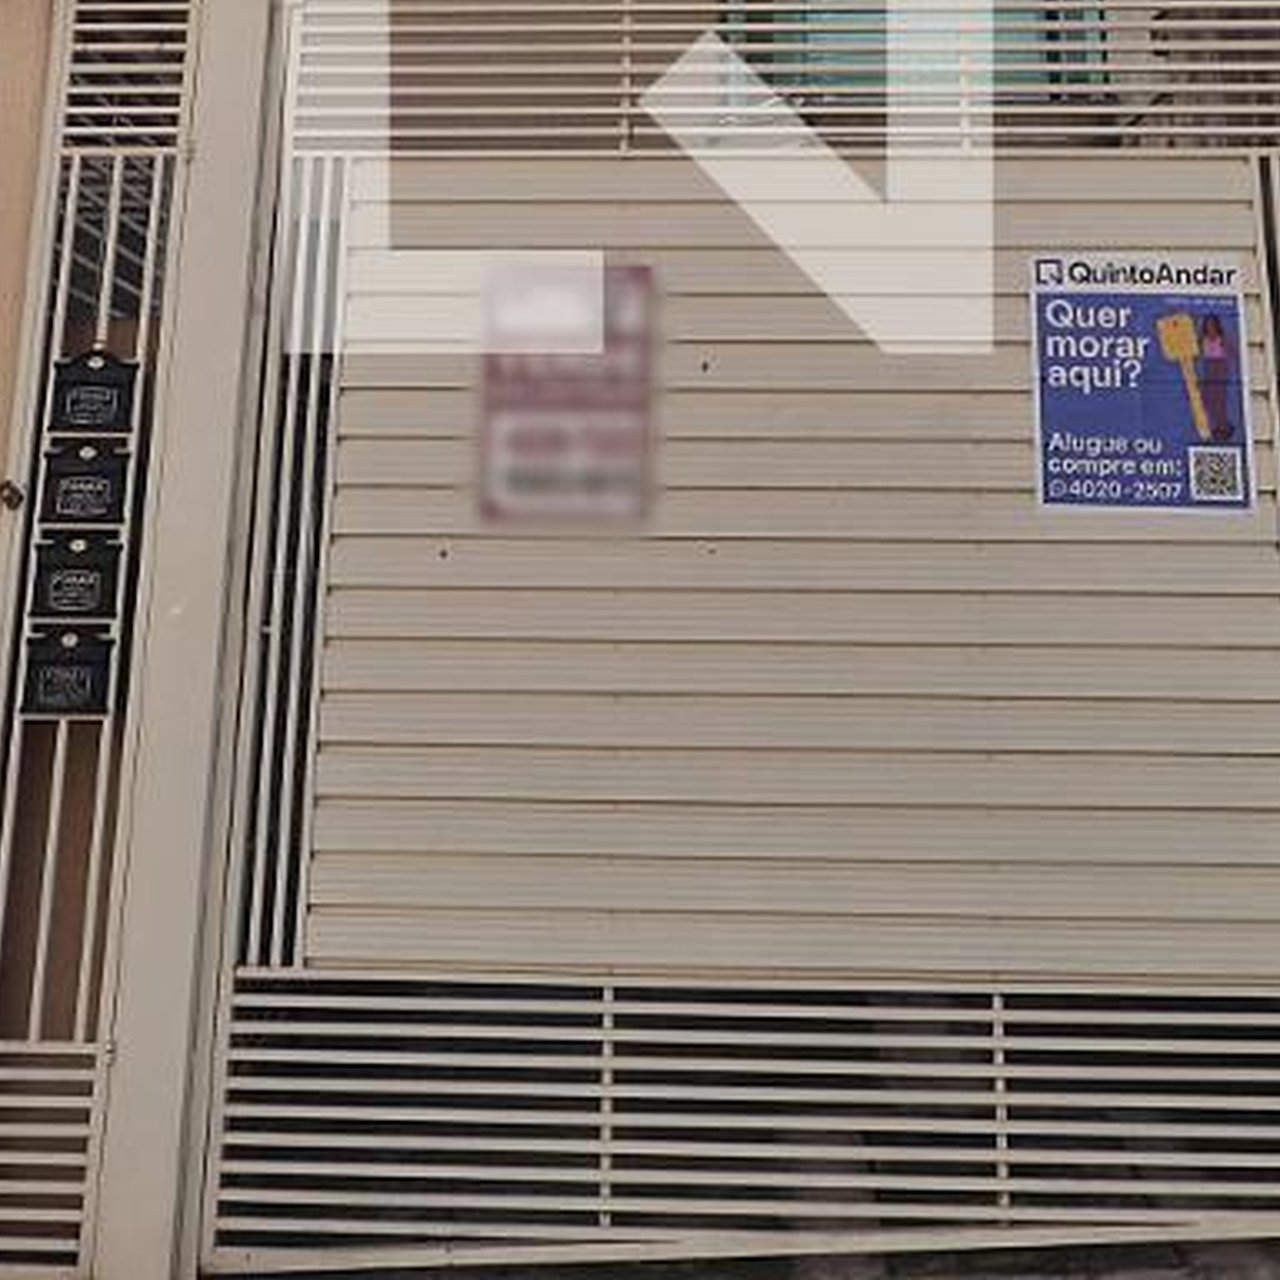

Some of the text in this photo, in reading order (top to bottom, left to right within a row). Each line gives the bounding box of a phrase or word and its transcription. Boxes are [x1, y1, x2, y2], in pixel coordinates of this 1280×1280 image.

[1069, 261, 1236, 285] QuintoAndar
[1045, 299, 1131, 328] Quer
[1046, 335, 1149, 357] morar
[1047, 359, 1142, 395] aqui?
[1048, 432, 1162, 457] Alugue ou
[1048, 458, 1182, 477] compre em:
